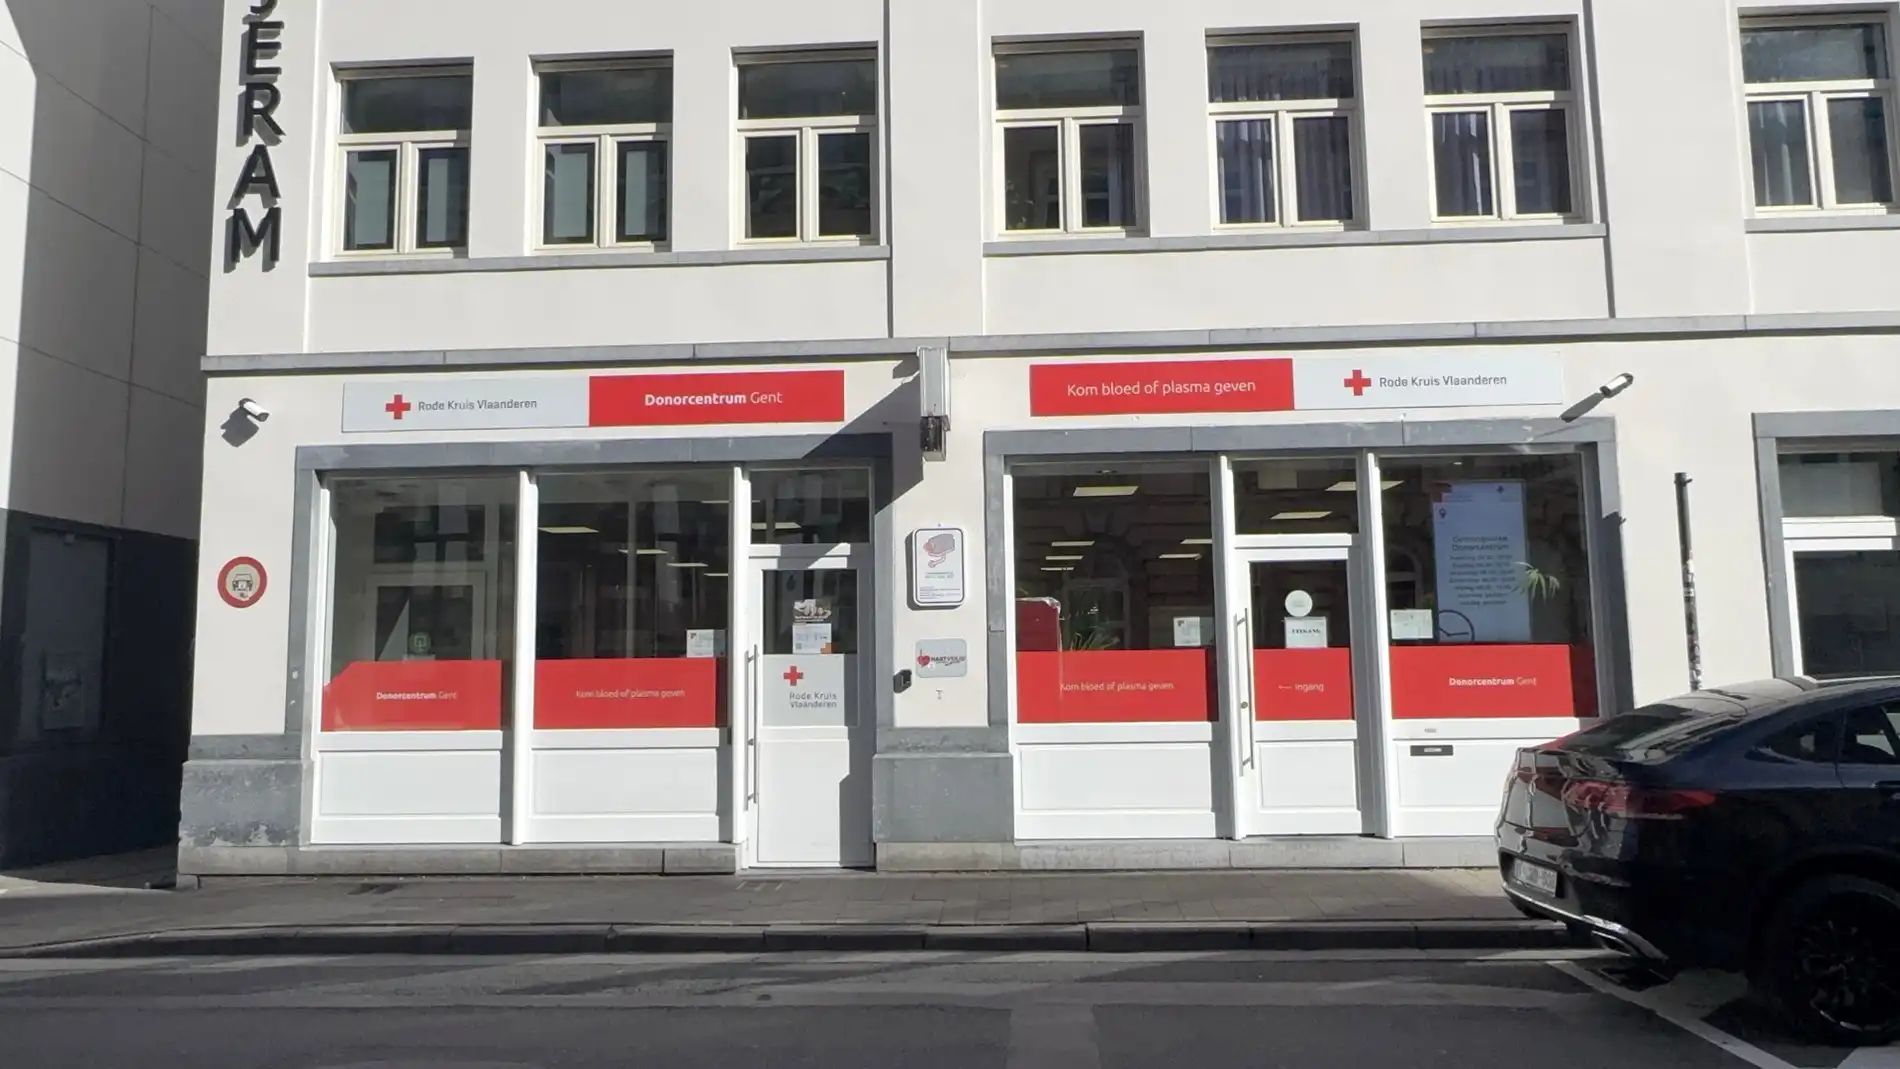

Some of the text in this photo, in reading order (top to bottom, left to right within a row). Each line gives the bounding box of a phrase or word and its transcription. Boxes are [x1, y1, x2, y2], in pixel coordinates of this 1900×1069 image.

[232, 0, 286, 263] ERAM
[1379, 375, 1507, 387] Rode Kruis Vlaanderen
[1067, 380, 1256, 396] Kom bloed of plasma geven
[644, 392, 783, 406] Donorcentrum Gent
[418, 399, 538, 412] Rode Kruis Vlaanderen
[1081, 682, 1105, 691] bloed
[1106, 681, 1116, 691] of
[1117, 681, 1147, 692] plasma
[1148, 682, 1174, 691] geven
[1448, 677, 1537, 686] Donorcentrum Gent
[376, 691, 437, 700] Donorcentrum
[596, 689, 619, 698] bloed
[620, 689, 630, 698] of
[630, 689, 659, 699] plasma
[790, 691, 837, 700] Rode Kruis
